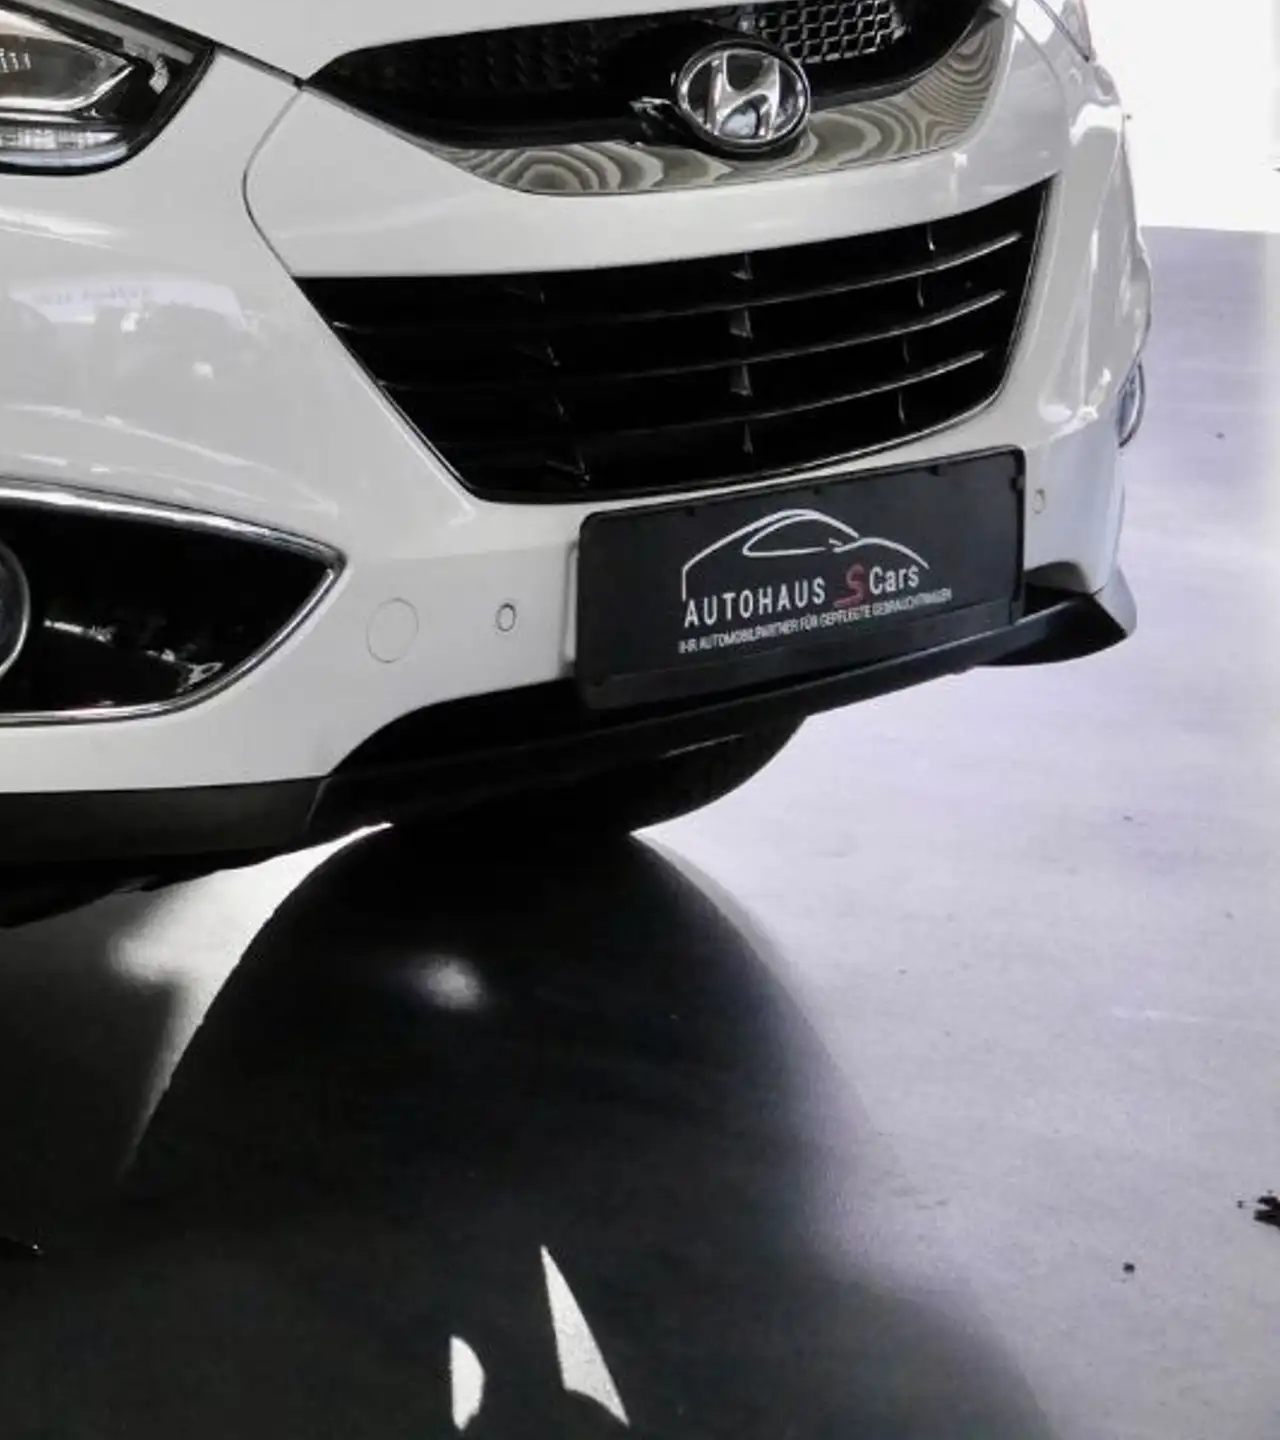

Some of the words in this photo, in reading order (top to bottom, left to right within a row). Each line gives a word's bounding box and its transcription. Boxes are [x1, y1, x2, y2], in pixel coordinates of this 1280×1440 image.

[684, 576, 826, 629] AUTOHAUS
[833, 563, 865, 609] S
[869, 564, 919, 596] Cars
